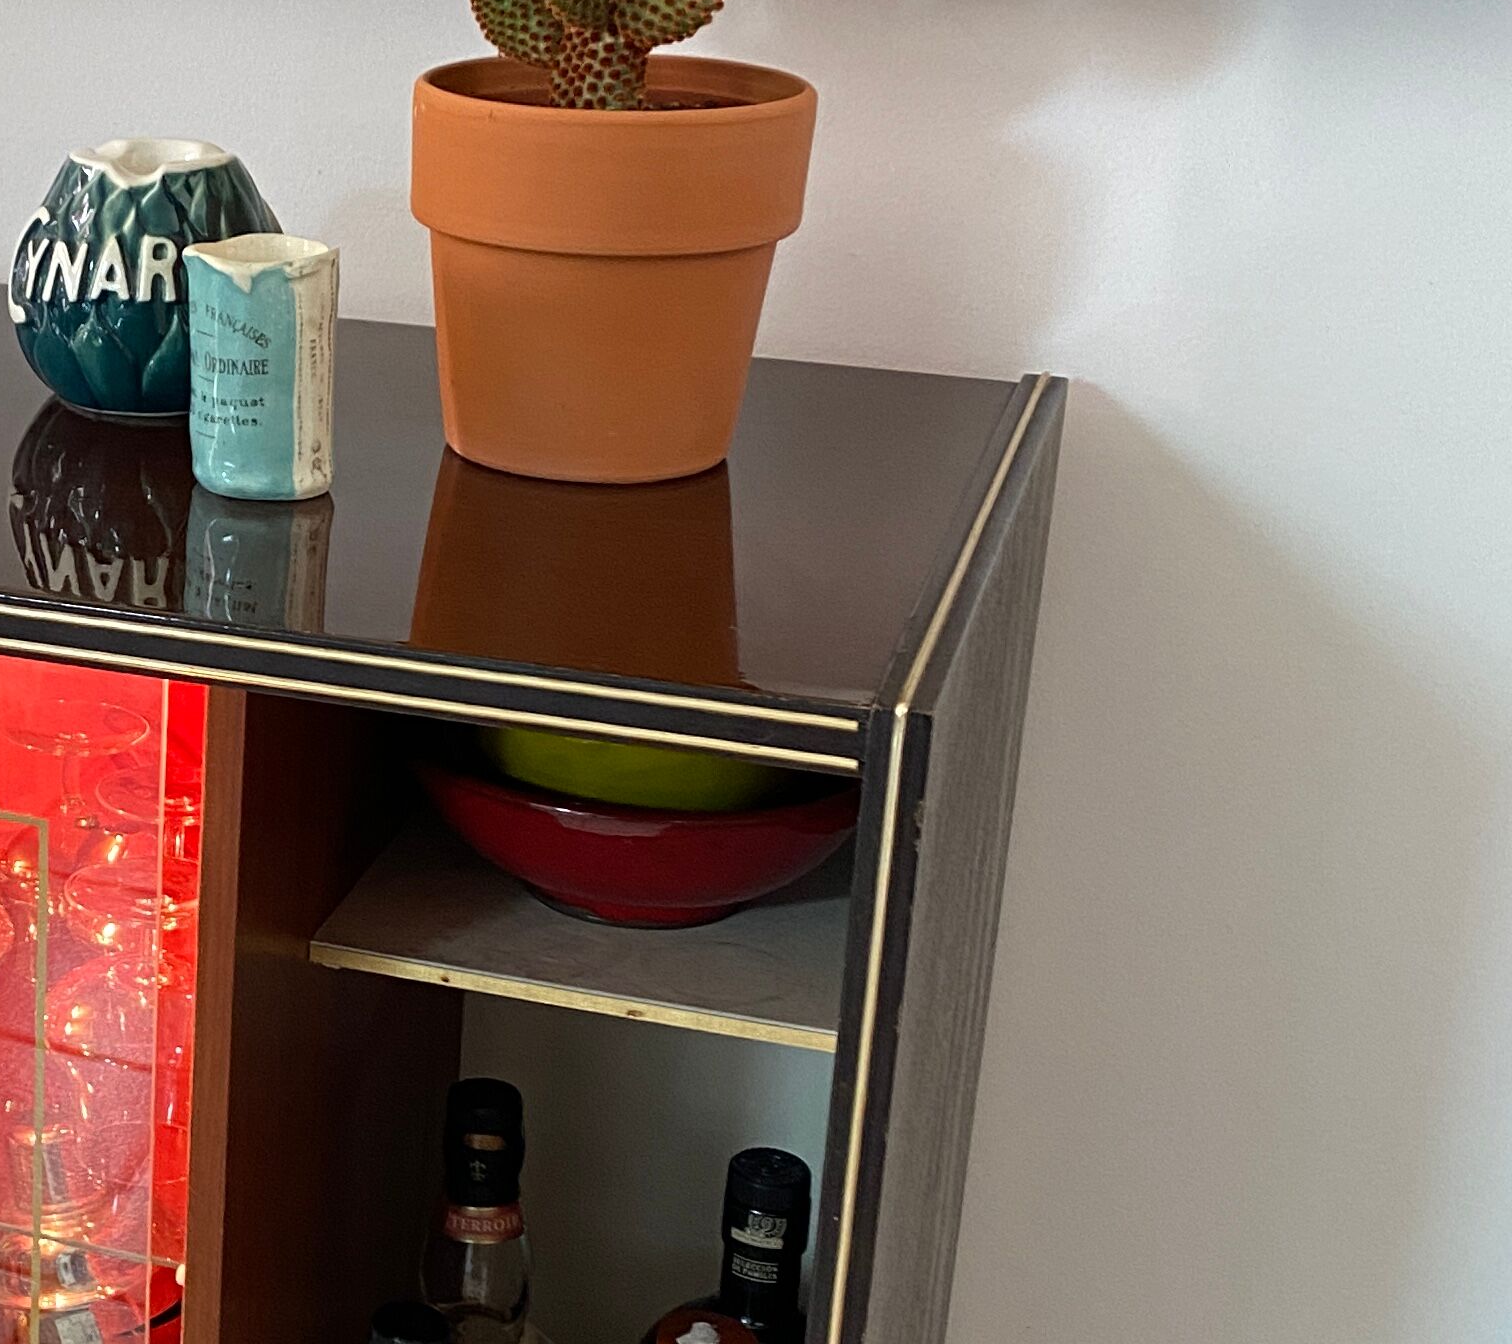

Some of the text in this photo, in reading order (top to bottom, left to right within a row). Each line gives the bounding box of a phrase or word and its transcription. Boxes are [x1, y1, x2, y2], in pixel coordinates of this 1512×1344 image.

[7, 206, 179, 324] CYNAR
[205, 302, 272, 351] FRANÇAISES
[204, 352, 270, 376] ORDINAIRE
